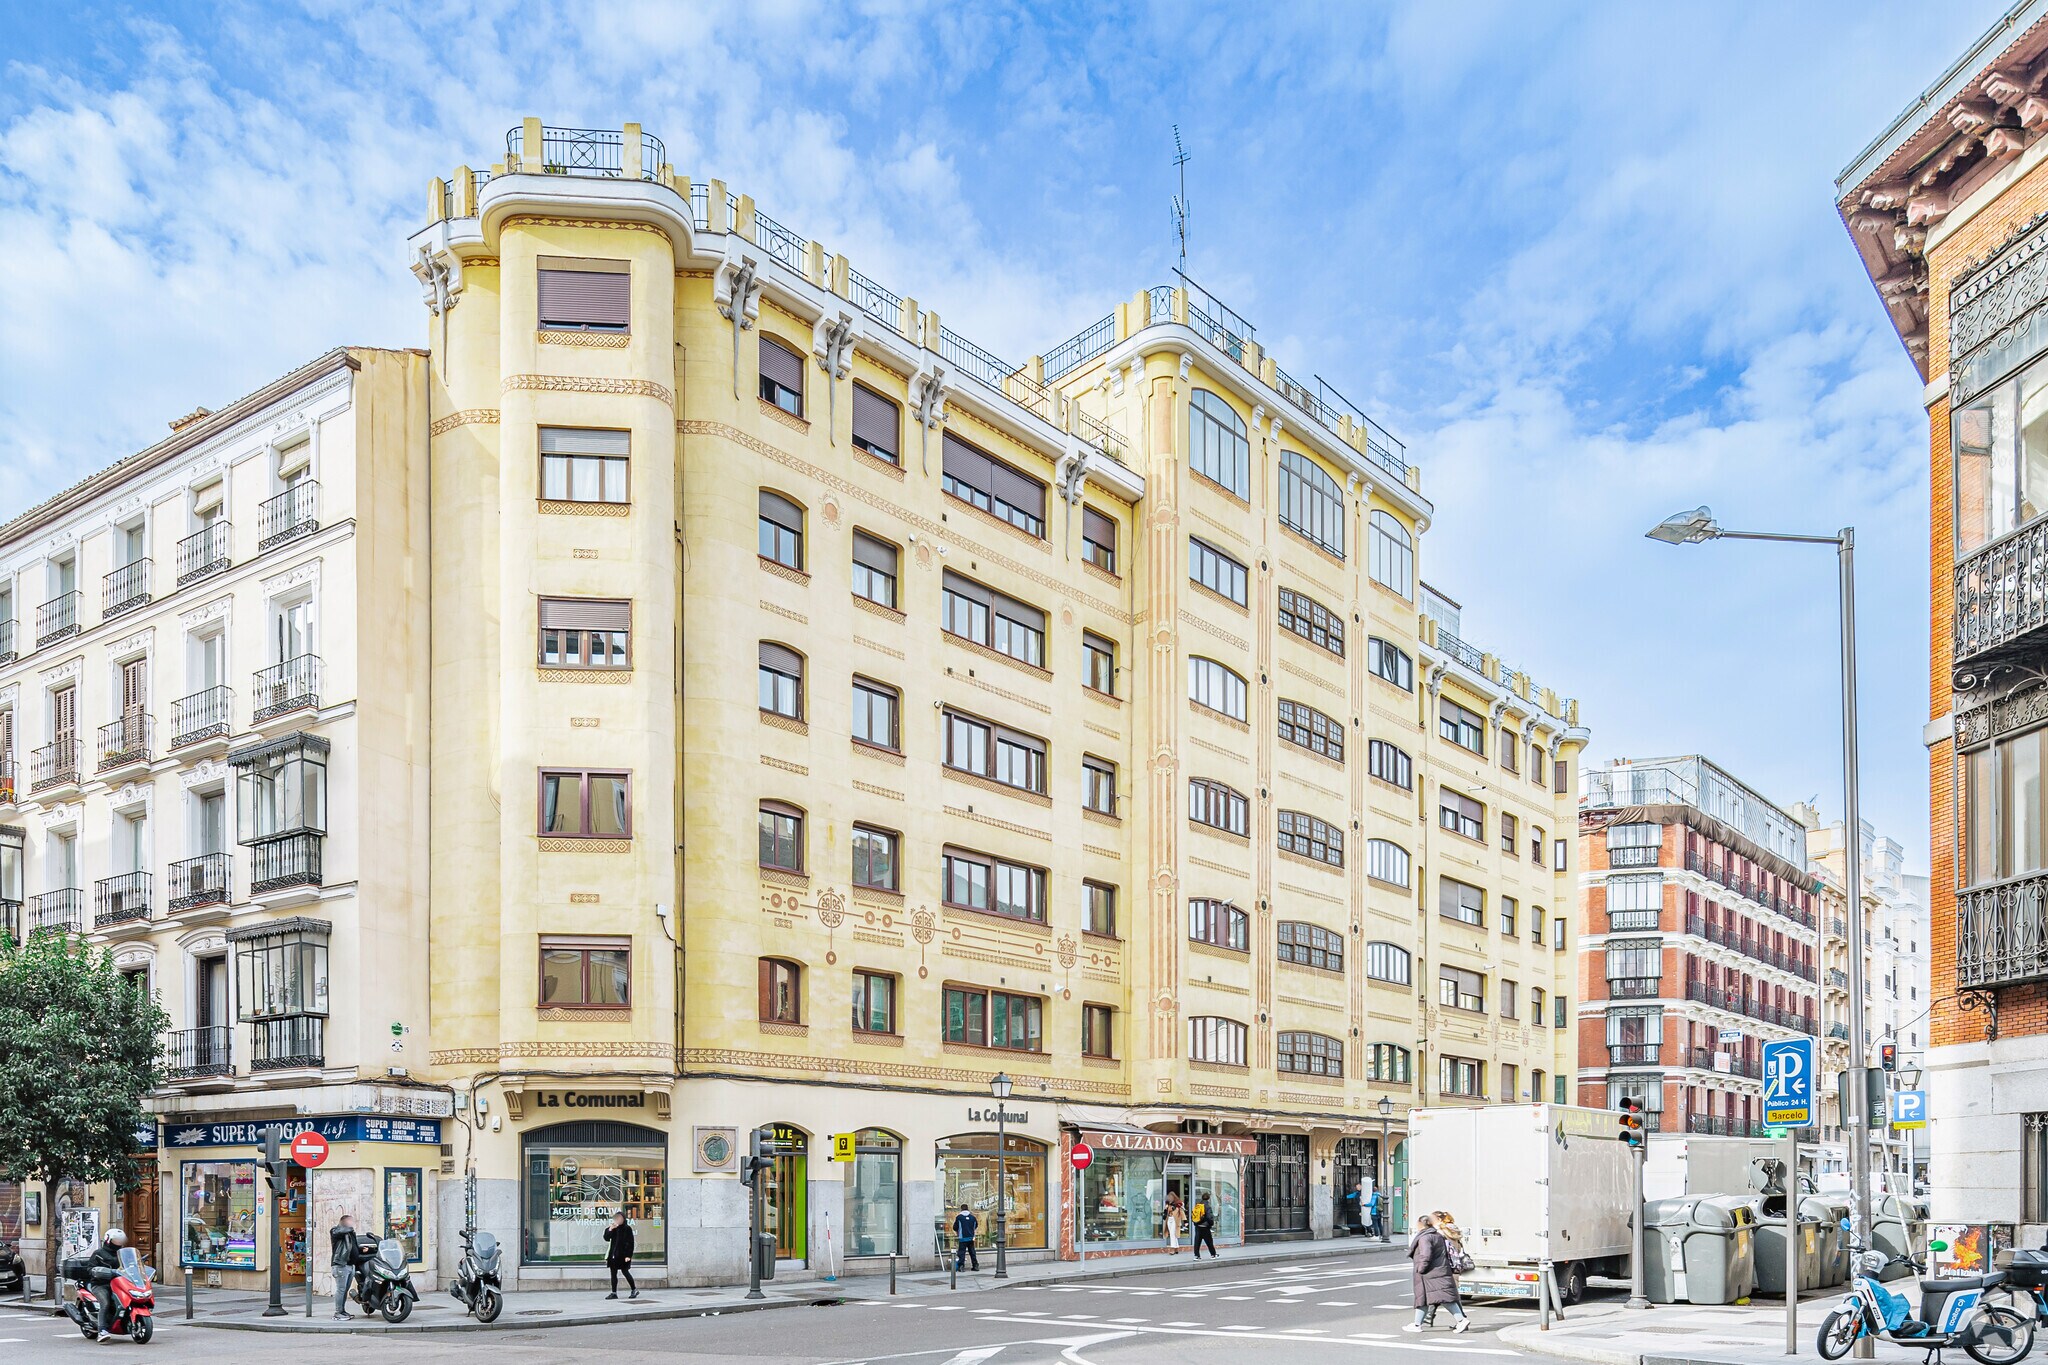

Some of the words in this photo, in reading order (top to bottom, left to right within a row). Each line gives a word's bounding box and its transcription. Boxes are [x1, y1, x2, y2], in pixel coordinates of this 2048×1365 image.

[1774, 1052, 1803, 1097] P
[537, 1091, 560, 1107] La
[564, 1091, 645, 1107] Comunal
[1898, 1094, 1920, 1119] P
[968, 1107, 982, 1122] La
[983, 1108, 1029, 1124] Comunal
[1772, 1111, 1803, 1120] Barcelo
[365, 1119, 388, 1129] SUPER
[392, 1120, 416, 1131] HOGAR
[212, 1124, 258, 1143] SUPER
[1102, 1134, 1183, 1151] CALZADOS
[1197, 1139, 1243, 1154] GALAN
[552, 1207, 582, 1216] ACEITE
[584, 1207, 596, 1216] DE
[575, 1218, 607, 1227] VIRGEN
